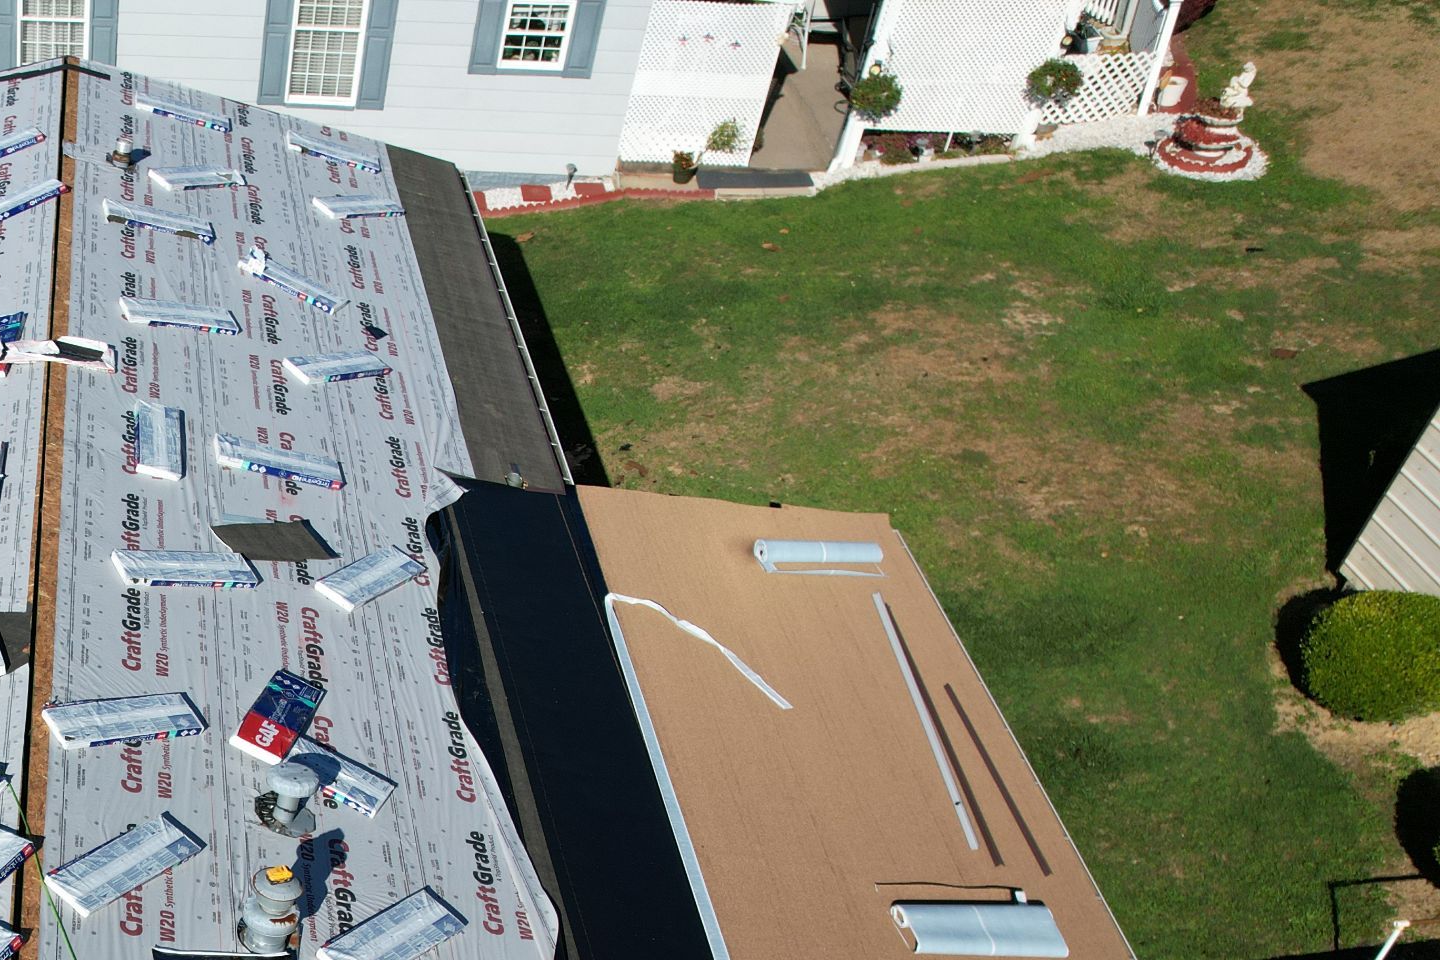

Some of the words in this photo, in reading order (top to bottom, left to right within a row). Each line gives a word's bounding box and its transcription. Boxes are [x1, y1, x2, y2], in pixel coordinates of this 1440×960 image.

[248, 185, 266, 225] CraftGrade
[344, 244, 366, 290] CraftGrade
[262, 294, 282, 345] CraftGrade
[121, 337, 138, 394] CraftGrade
[387, 341, 398, 357] W20
[149, 382, 160, 399] W20
[270, 359, 292, 416] CraftGrade
[403, 409, 415, 426] W20
[257, 427, 269, 444] W20
[385, 436, 412, 499] CraftGrade
[160, 594, 168, 624] Underlayment
[276, 601, 289, 623] W20
[121, 587, 141, 671] CraftGrade
[160, 624, 171, 652] Synthetic
[301, 606, 328, 689] CraftGrade
[156, 653, 169, 677] W20
[255, 720, 279, 747] GAF
[164, 741, 172, 770] Synthetic
[442, 711, 476, 803] CraftGrade
[158, 771, 172, 799] W20
[165, 874, 176, 909] Synthetic
[466, 831, 505, 935] CraftGrade
[160, 910, 175, 943] W20
